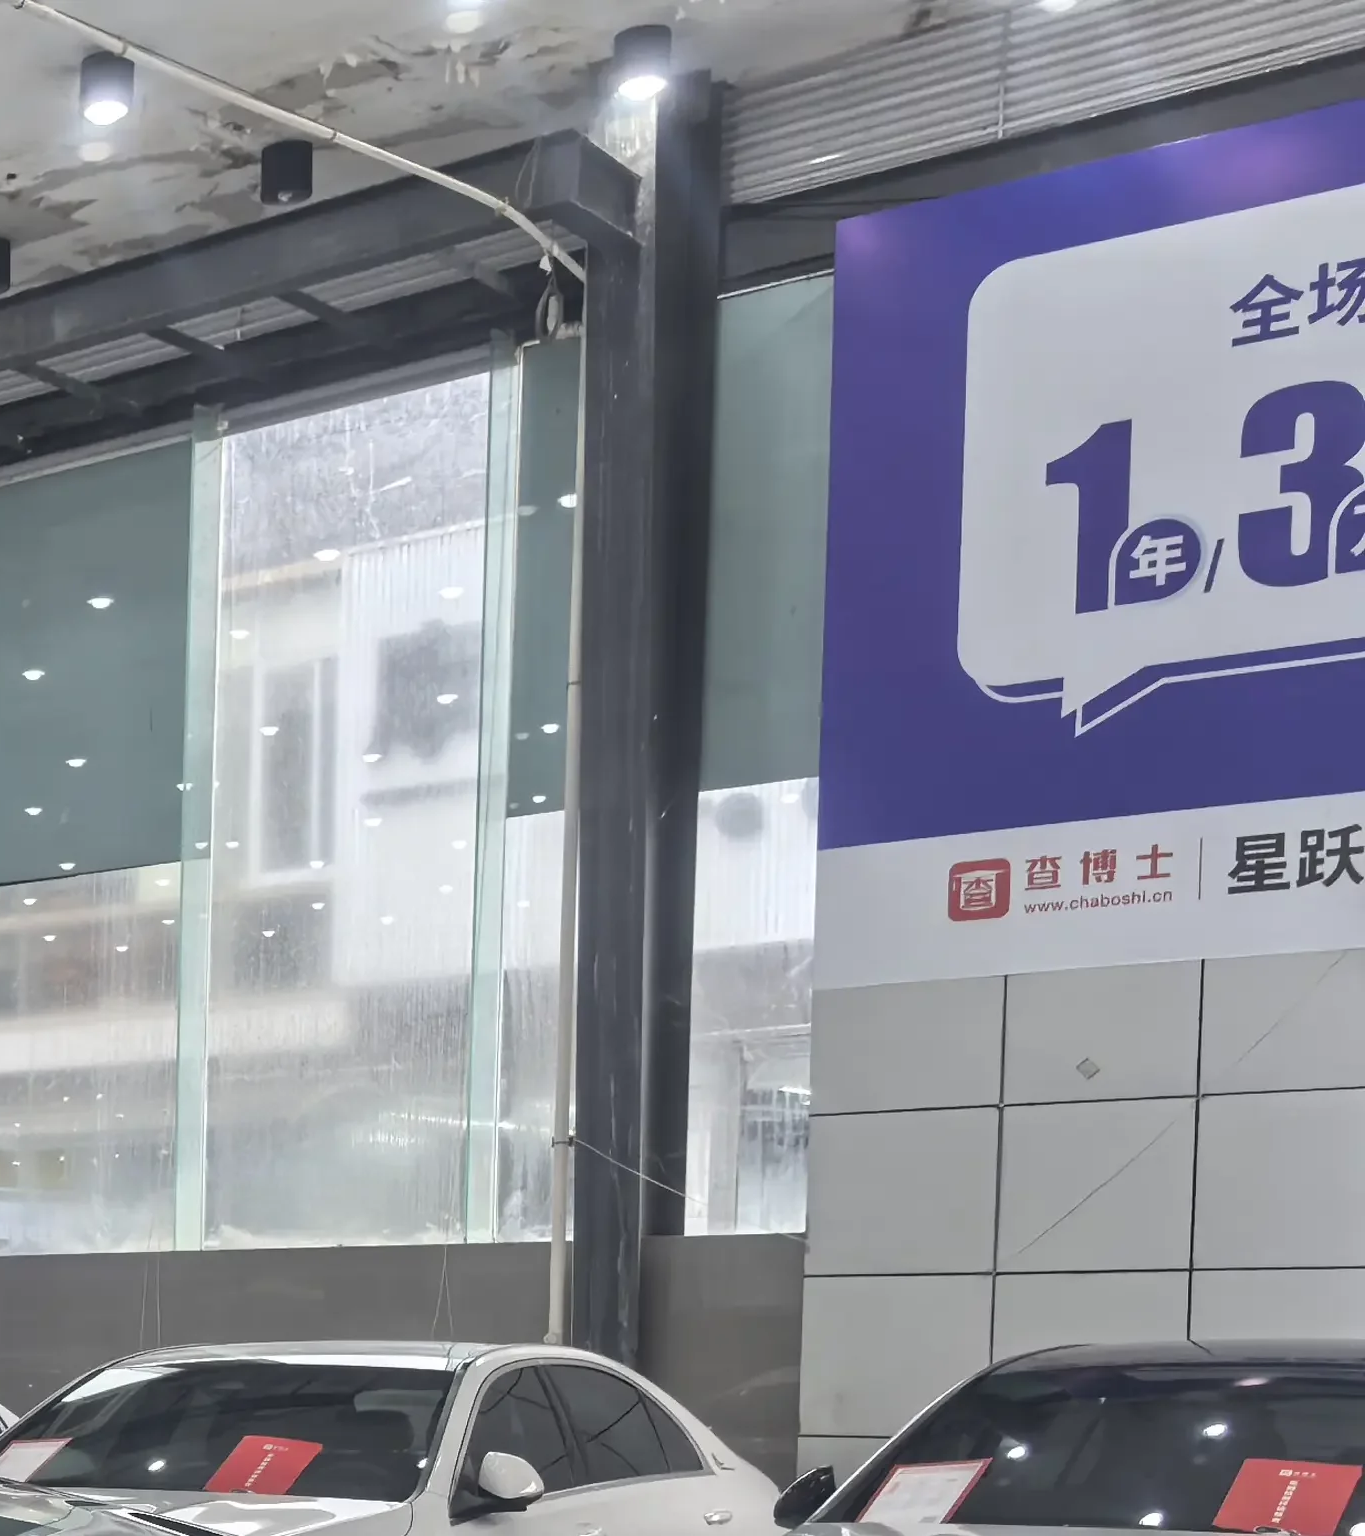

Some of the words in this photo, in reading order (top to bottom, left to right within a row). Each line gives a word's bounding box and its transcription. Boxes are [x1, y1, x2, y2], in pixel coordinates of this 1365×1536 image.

[1230, 257, 1365, 348] 全场
[1024, 843, 1174, 891] 查博士
[1227, 823, 1365, 895] 星跃
[1024, 888, 1173, 915] www.chaboshi.cn
